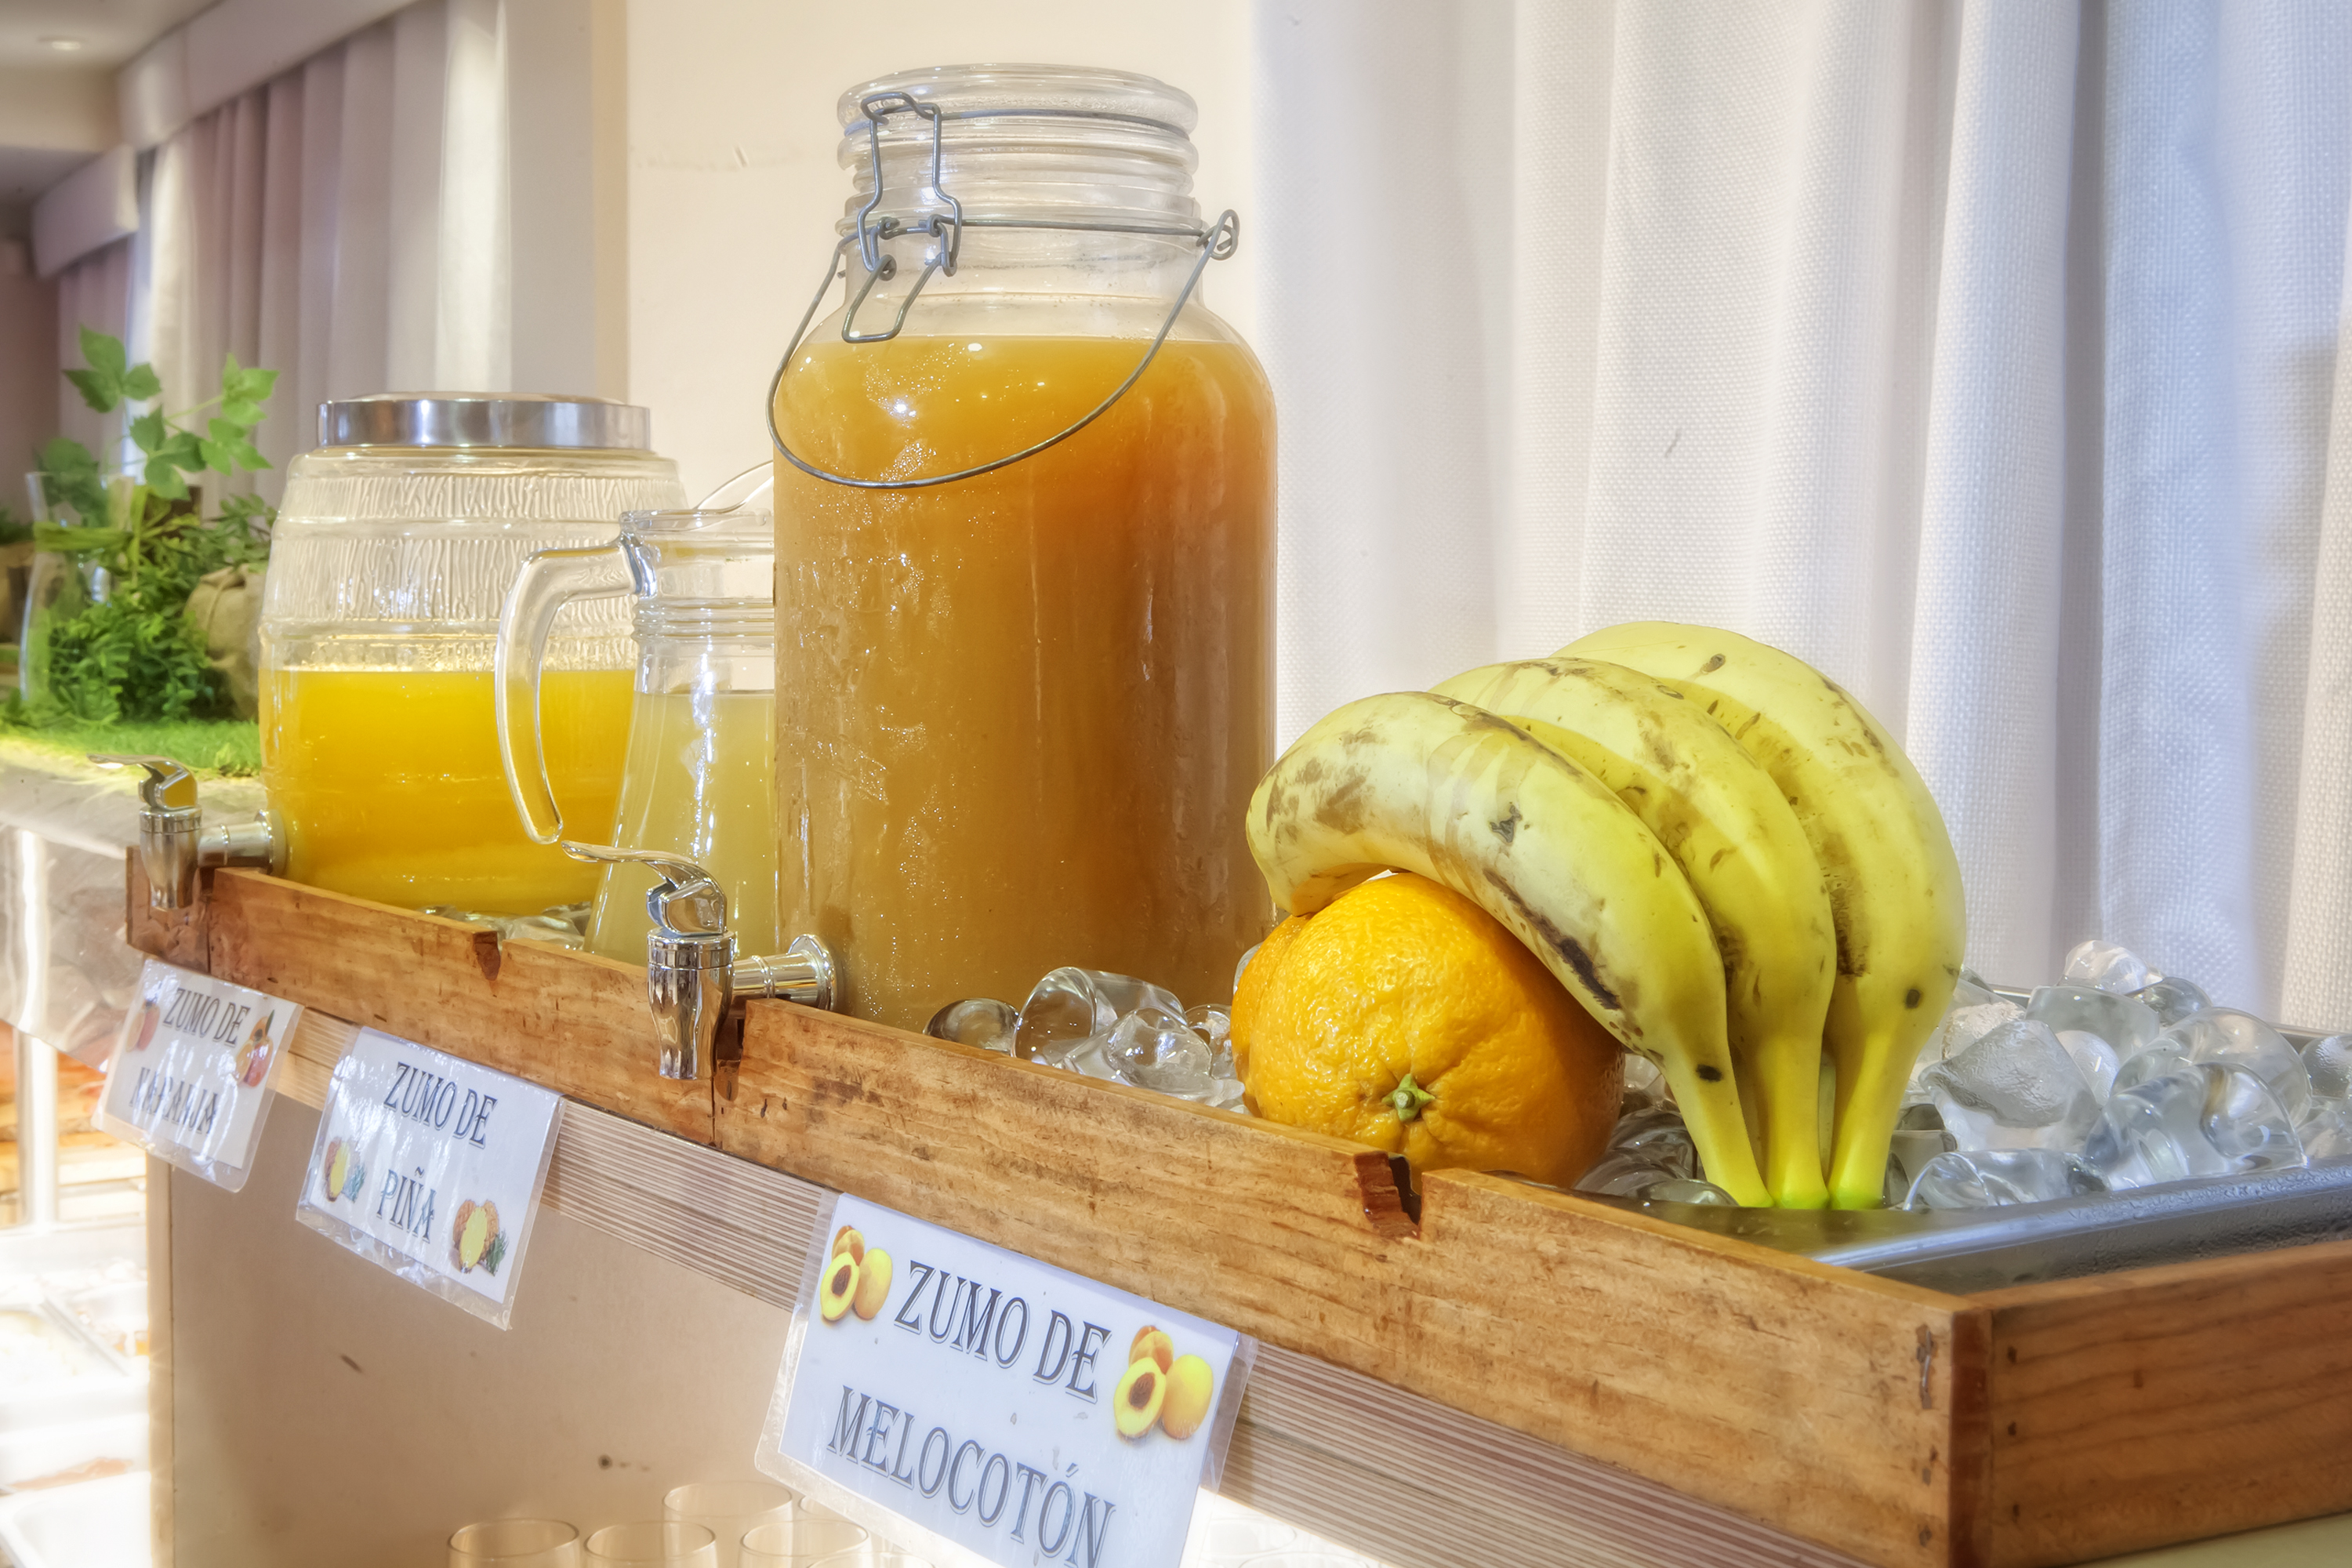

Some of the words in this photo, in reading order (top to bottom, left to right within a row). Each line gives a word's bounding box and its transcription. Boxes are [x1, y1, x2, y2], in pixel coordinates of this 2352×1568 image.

[162, 987, 220, 1038] ZUMO
[213, 1002, 251, 1046] DE
[383, 1061, 458, 1131] ZUMO
[454, 1088, 497, 1147] DE
[376, 1167, 437, 1243] PIÑA
[894, 1260, 1029, 1368] ZUMO
[1033, 1309, 1112, 1403] DE
[827, 1385, 1116, 1568] MELOCOTÓN
